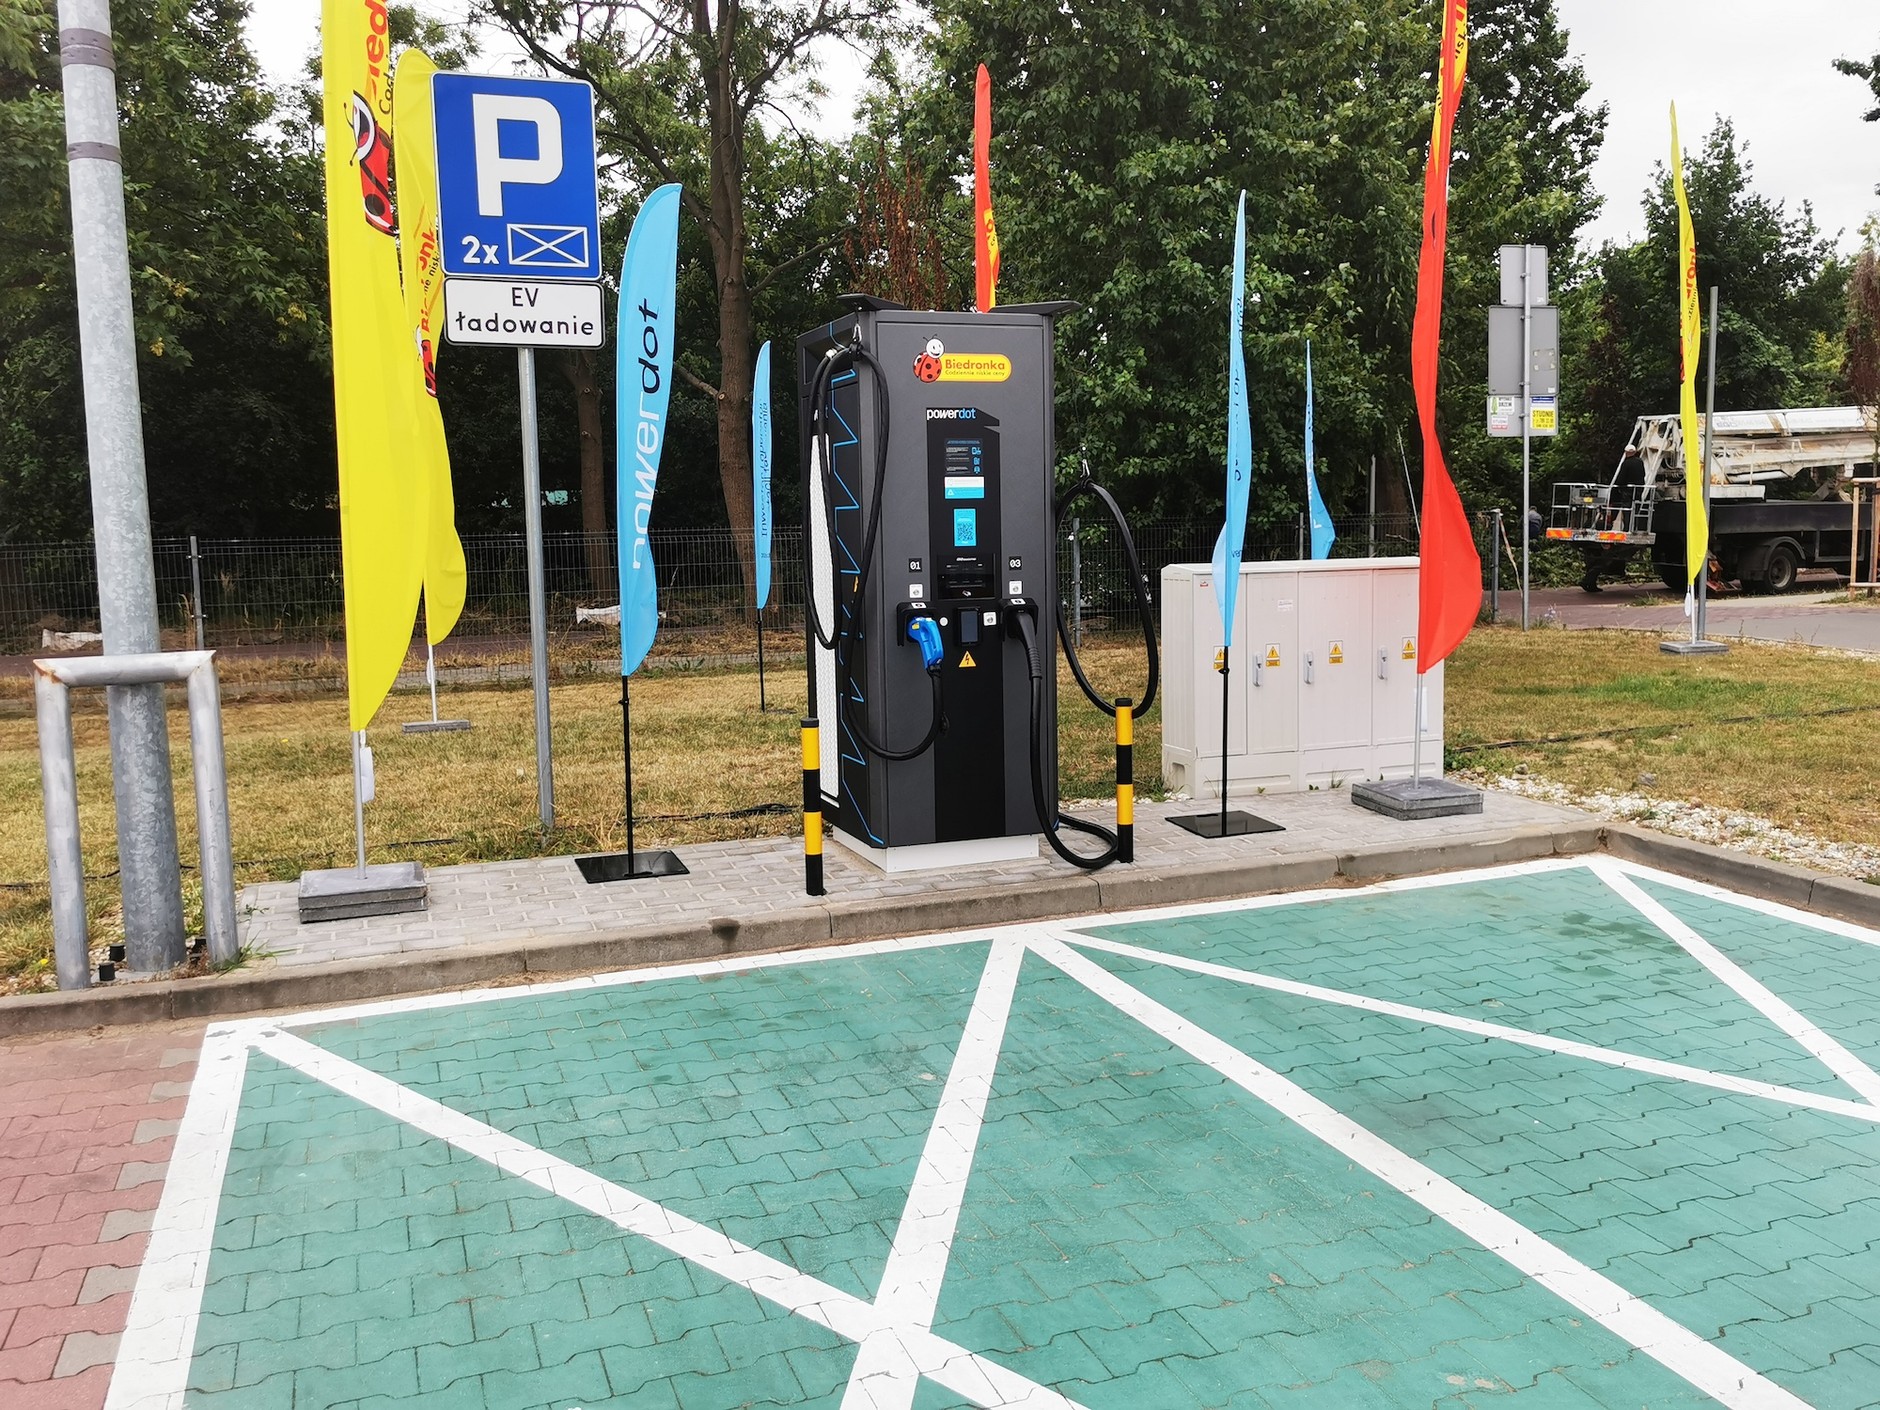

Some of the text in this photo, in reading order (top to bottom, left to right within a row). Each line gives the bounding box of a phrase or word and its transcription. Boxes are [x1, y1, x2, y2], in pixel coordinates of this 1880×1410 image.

[472, 93, 564, 217] P
[461, 235, 500, 265] 2x
[511, 286, 539, 307] EV
[455, 311, 594, 336] ładowanie
[945, 359, 1005, 370] Biedronka
[926, 408, 976, 420] powerdot
[910, 562, 921, 570] 01
[1009, 559, 1021, 568] 03
